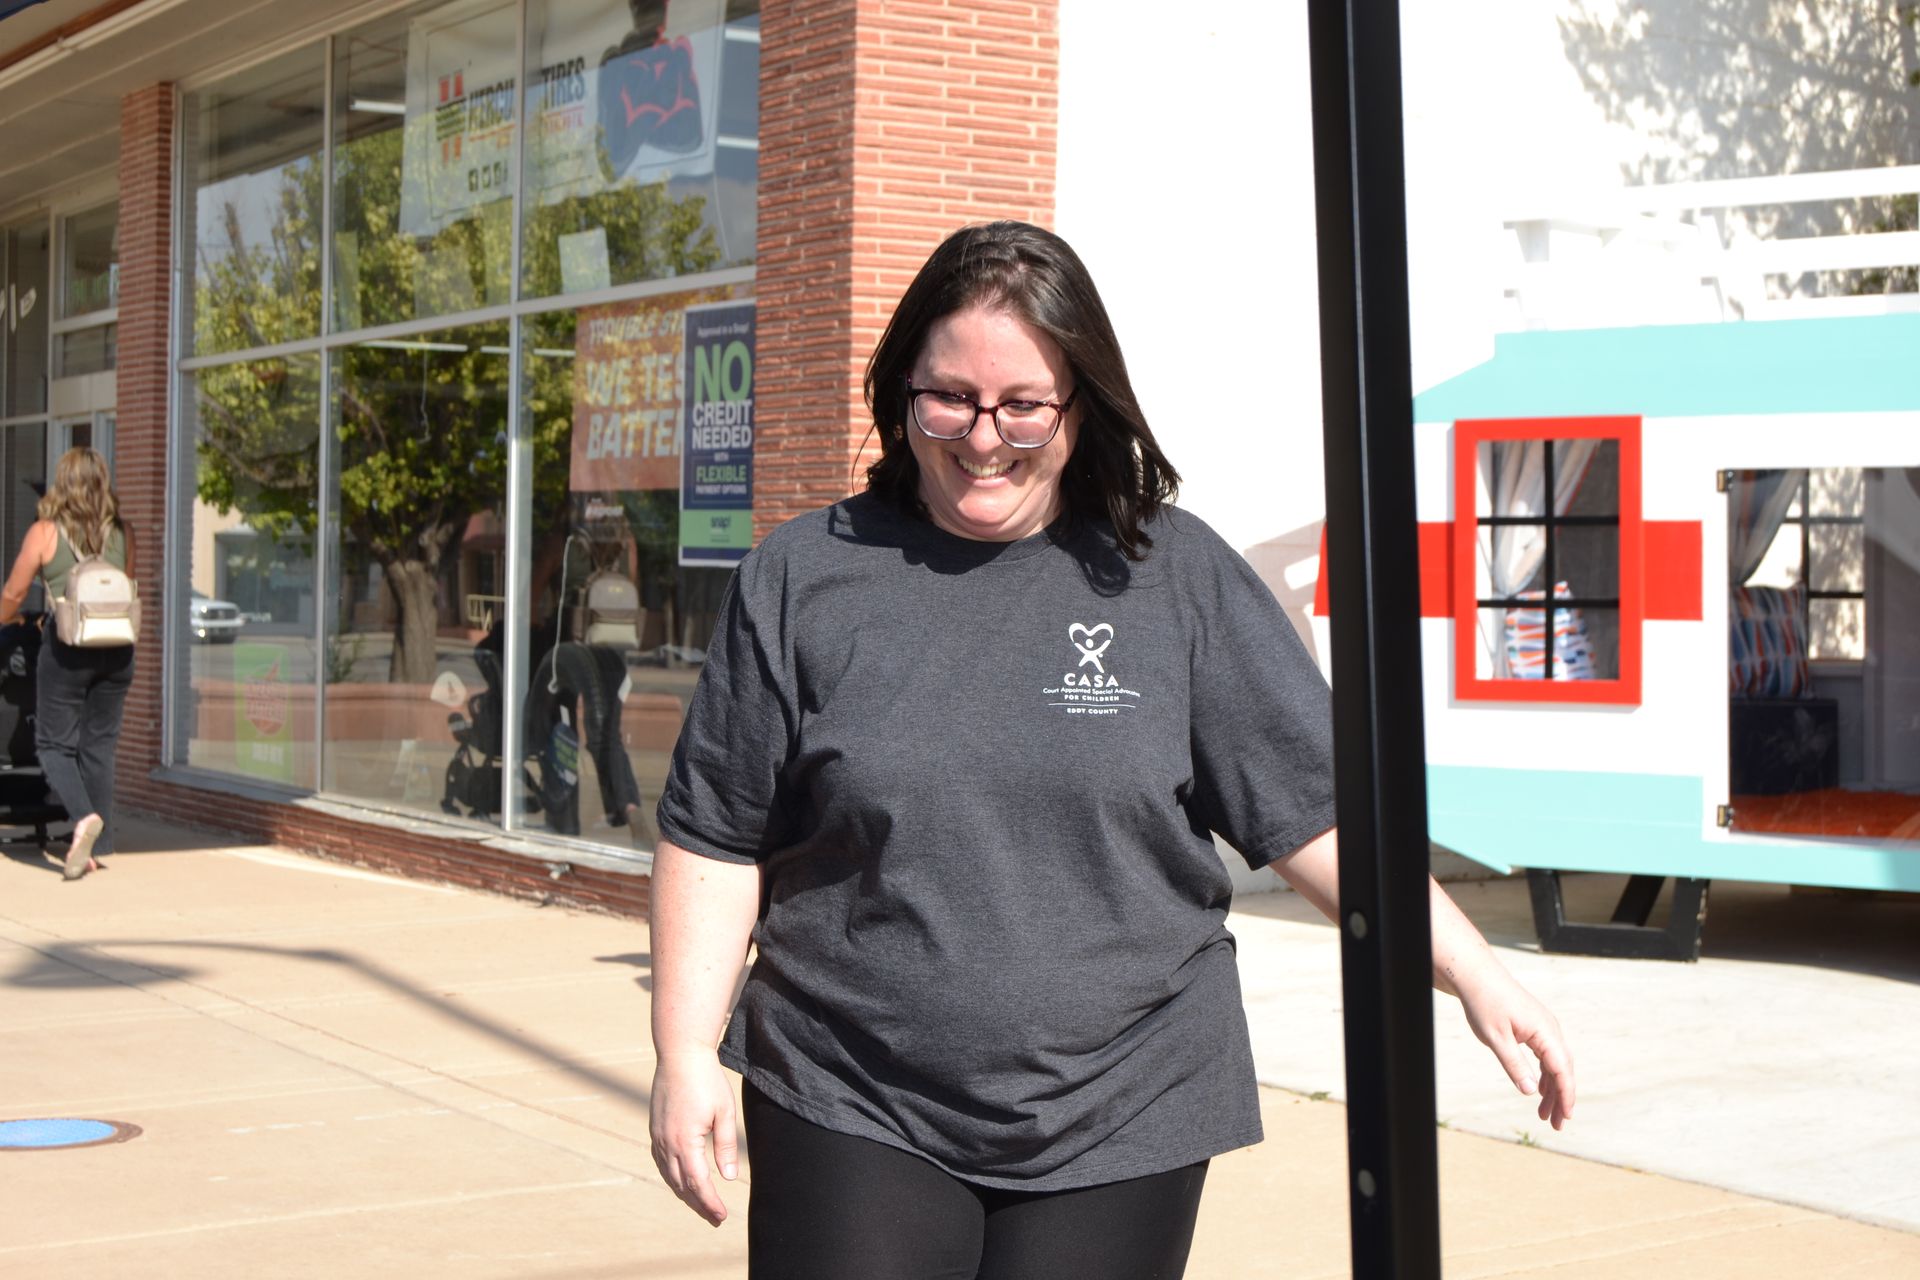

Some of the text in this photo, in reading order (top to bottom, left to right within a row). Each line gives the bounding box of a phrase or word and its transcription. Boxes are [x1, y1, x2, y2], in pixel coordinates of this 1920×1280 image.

[586, 357, 632, 406] WE
[694, 340, 752, 403] NO
[693, 400, 752, 426] CREDIT
[692, 426, 752, 449] NEEDED
[696, 465, 747, 483] FLEXIBLE
[1060, 686, 1091, 694] Appointed
[1063, 672, 1119, 688] CASA
